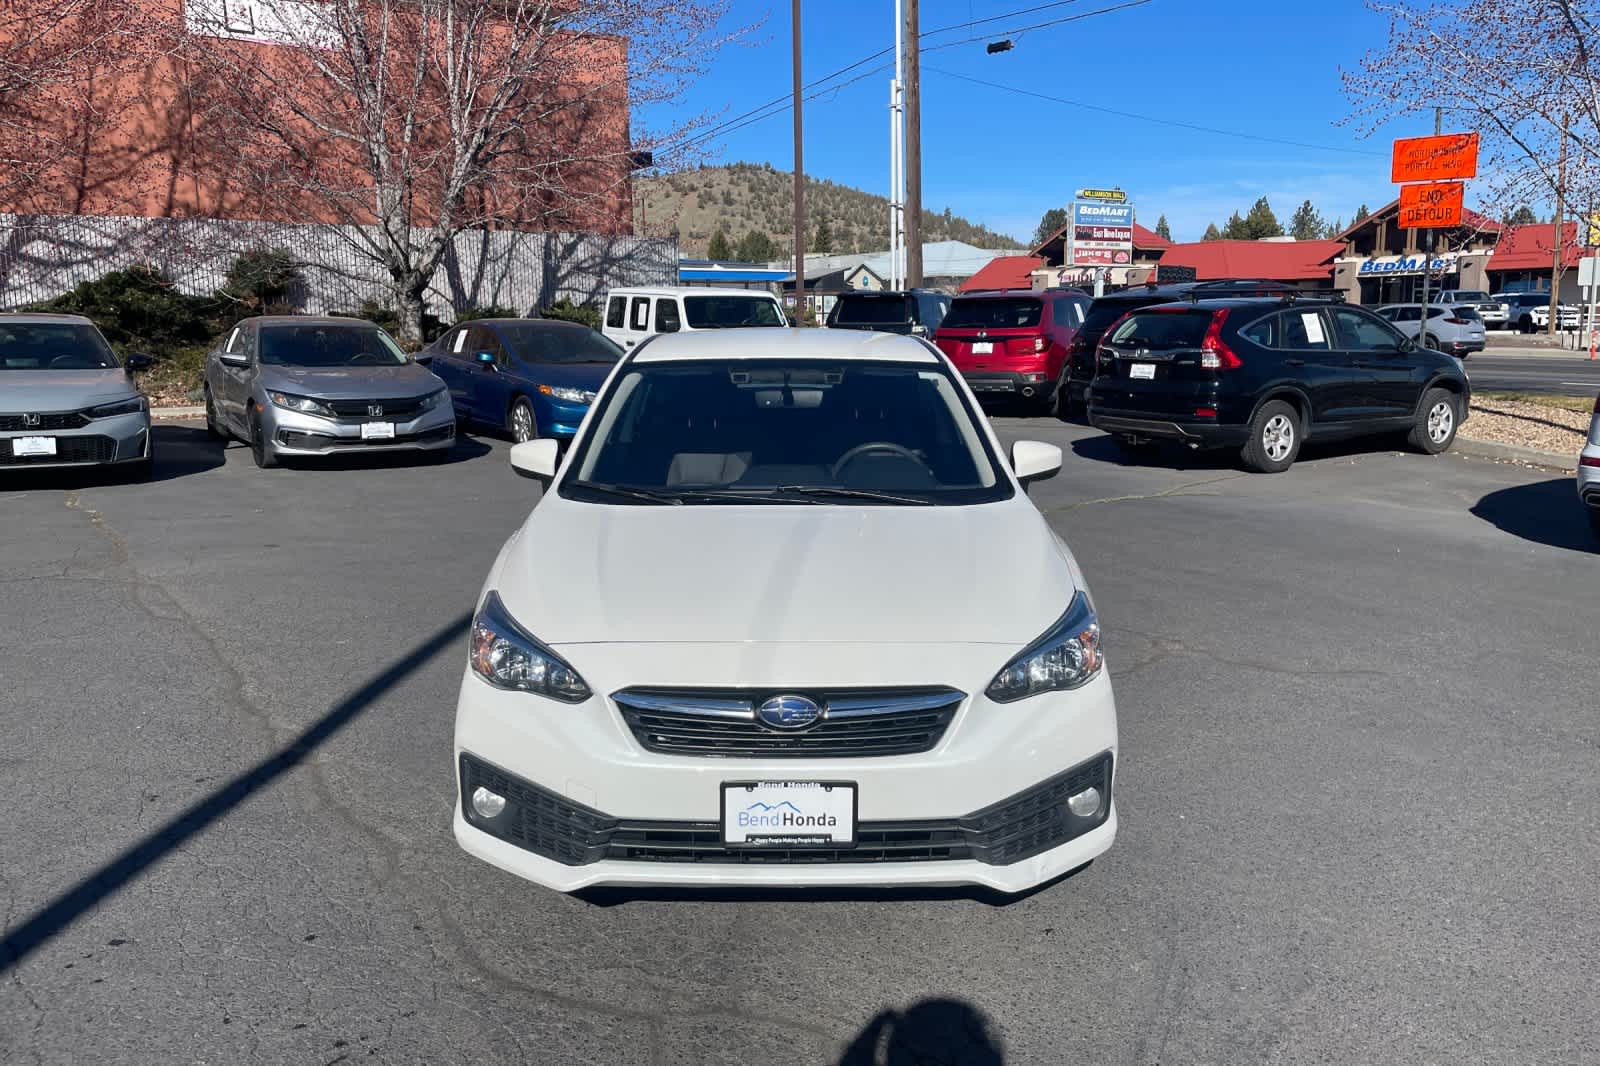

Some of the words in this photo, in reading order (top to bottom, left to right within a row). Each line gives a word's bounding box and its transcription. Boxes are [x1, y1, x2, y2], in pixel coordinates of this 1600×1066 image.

[1419, 189, 1443, 203] END
[1407, 207, 1453, 221] DETOUR
[738, 811, 780, 827] Bend
[782, 811, 837, 827] Honda
